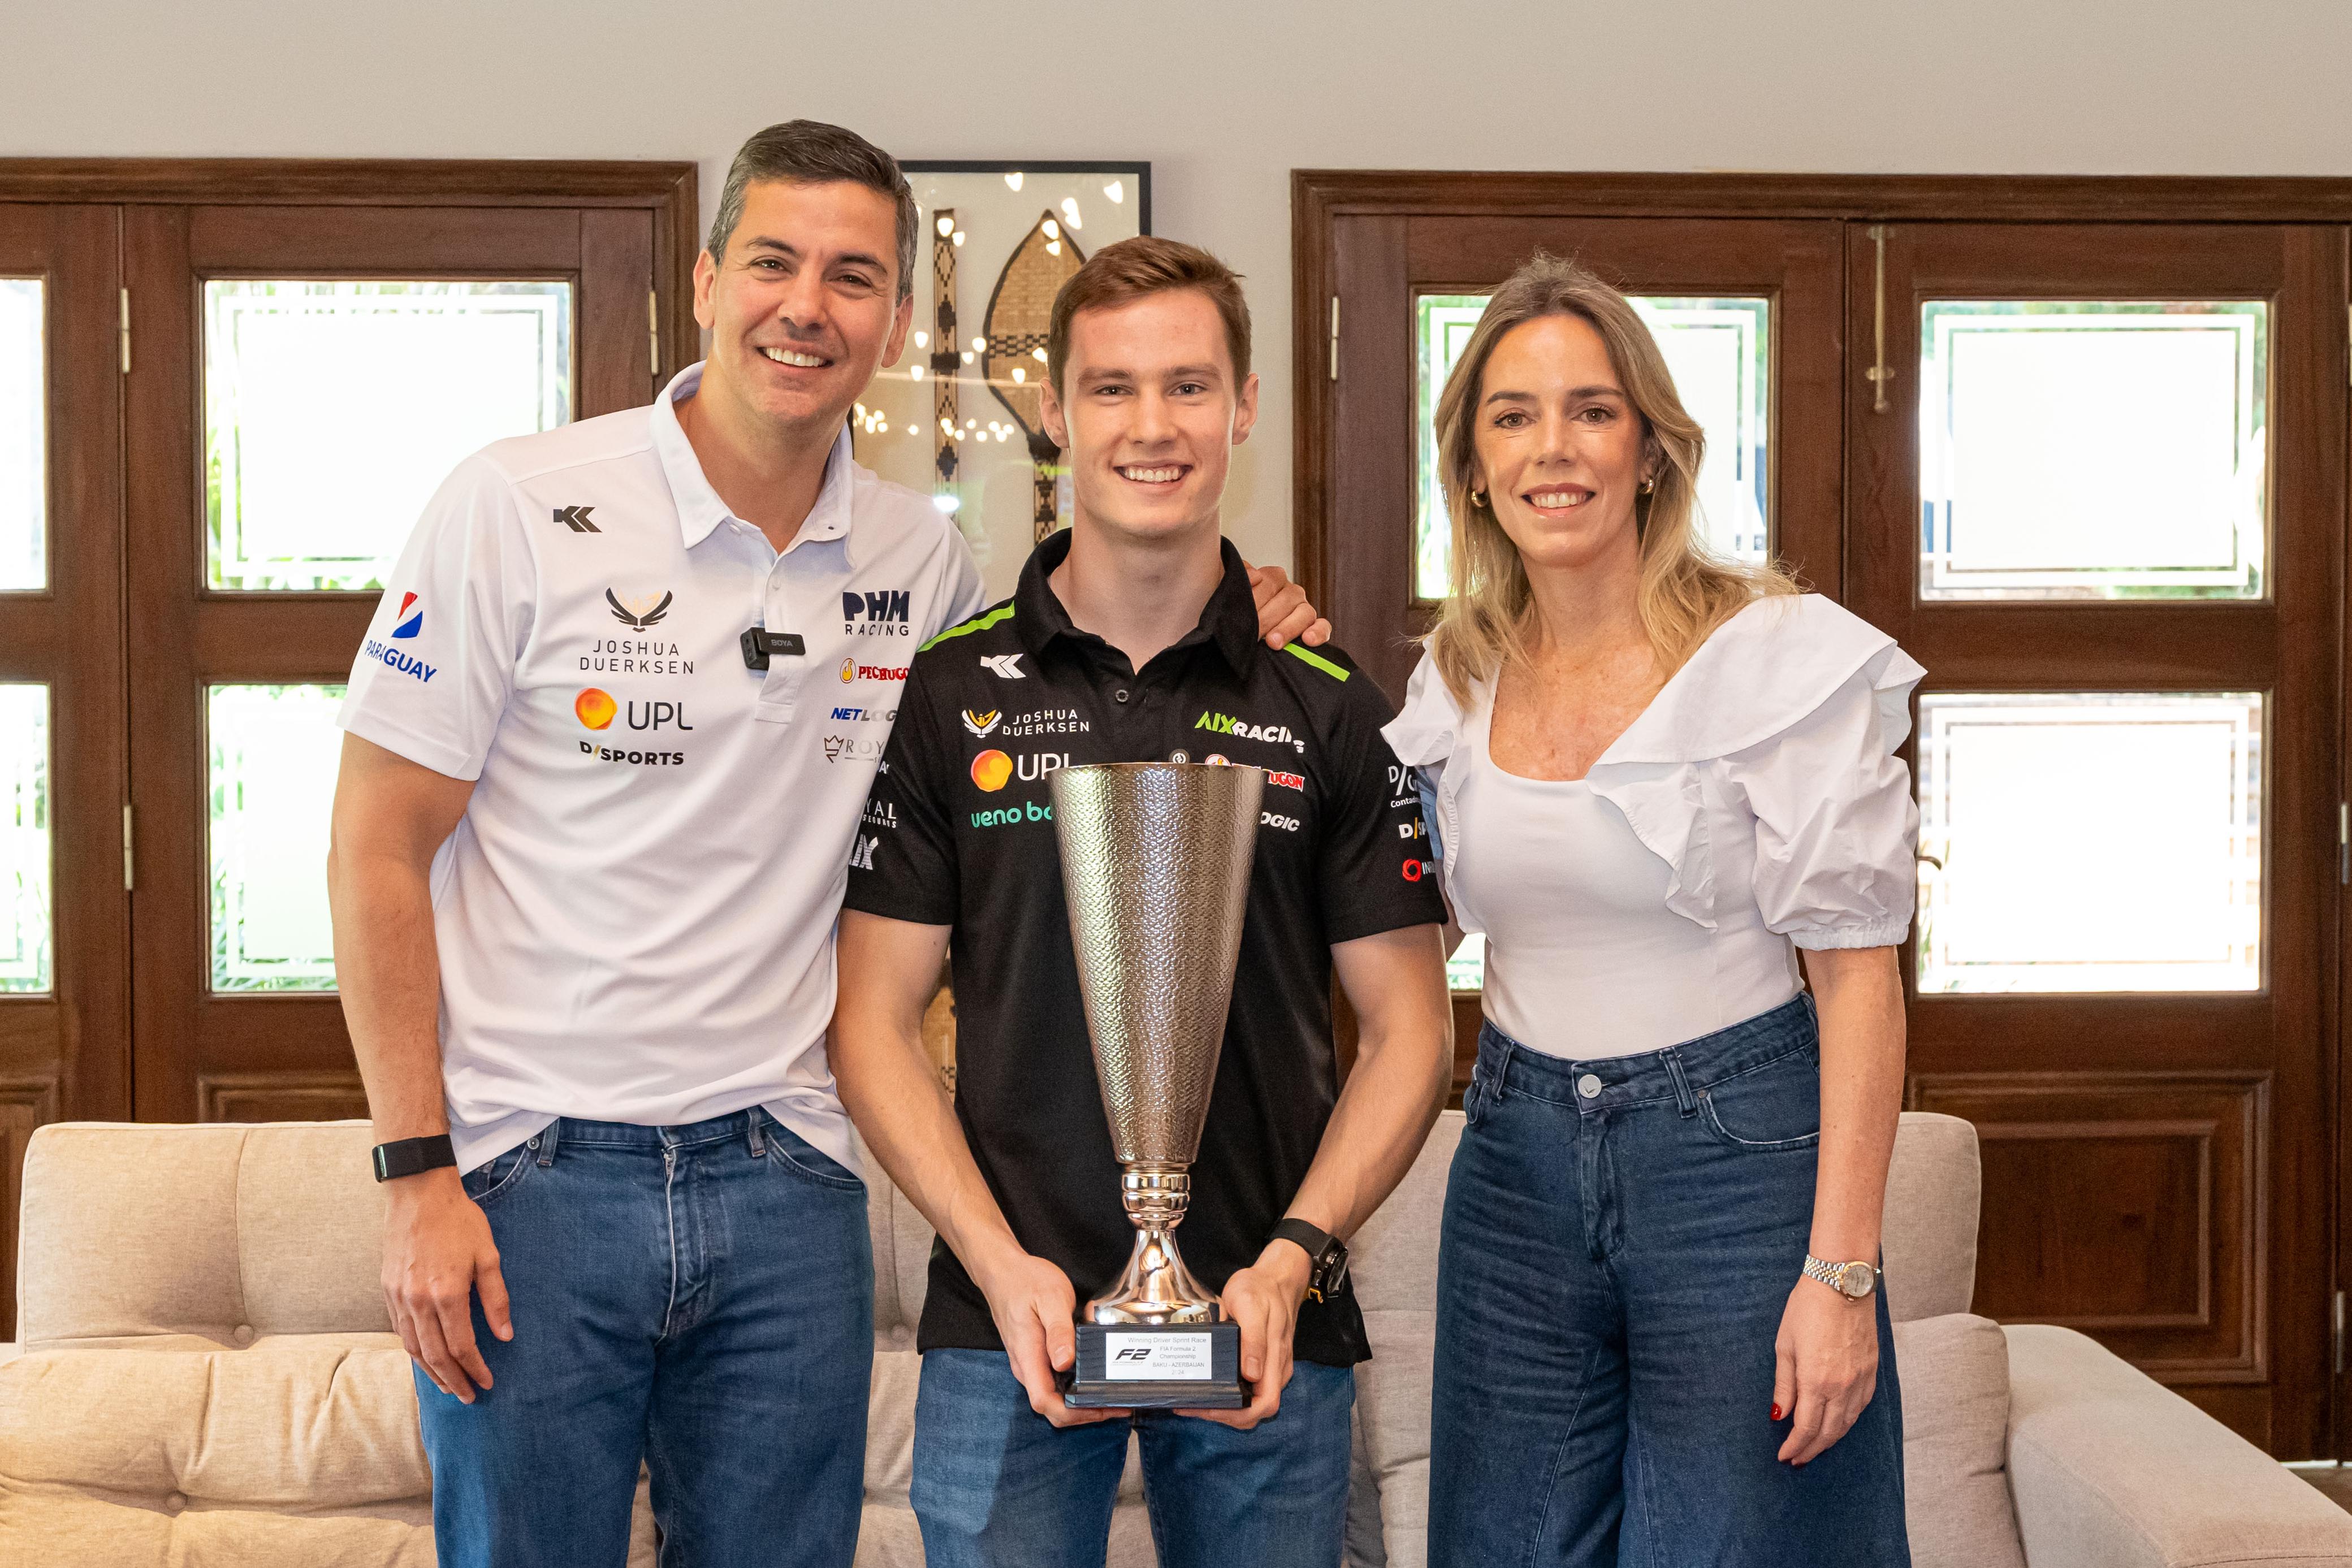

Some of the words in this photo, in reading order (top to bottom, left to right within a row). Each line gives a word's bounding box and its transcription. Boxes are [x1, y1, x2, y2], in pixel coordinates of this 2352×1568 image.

[842, 590, 910, 622] PHM
[845, 624, 910, 636] RACING
[593, 640, 680, 656] JOSHUA
[771, 639, 793, 647] BOYA
[364, 639, 438, 683] PARAGUAY
[580, 657, 694, 675] DUERKSEN
[857, 665, 910, 681] PECHUGO
[628, 700, 694, 731] UPL
[830, 707, 898, 722] NETLOG
[1012, 709, 1078, 725] JOSHUA
[1002, 721, 1089, 737] DUERKSEN
[846, 739, 885, 755] ROY
[866, 798, 897, 819] YAL
[1115, 1349, 1152, 1361] F2
